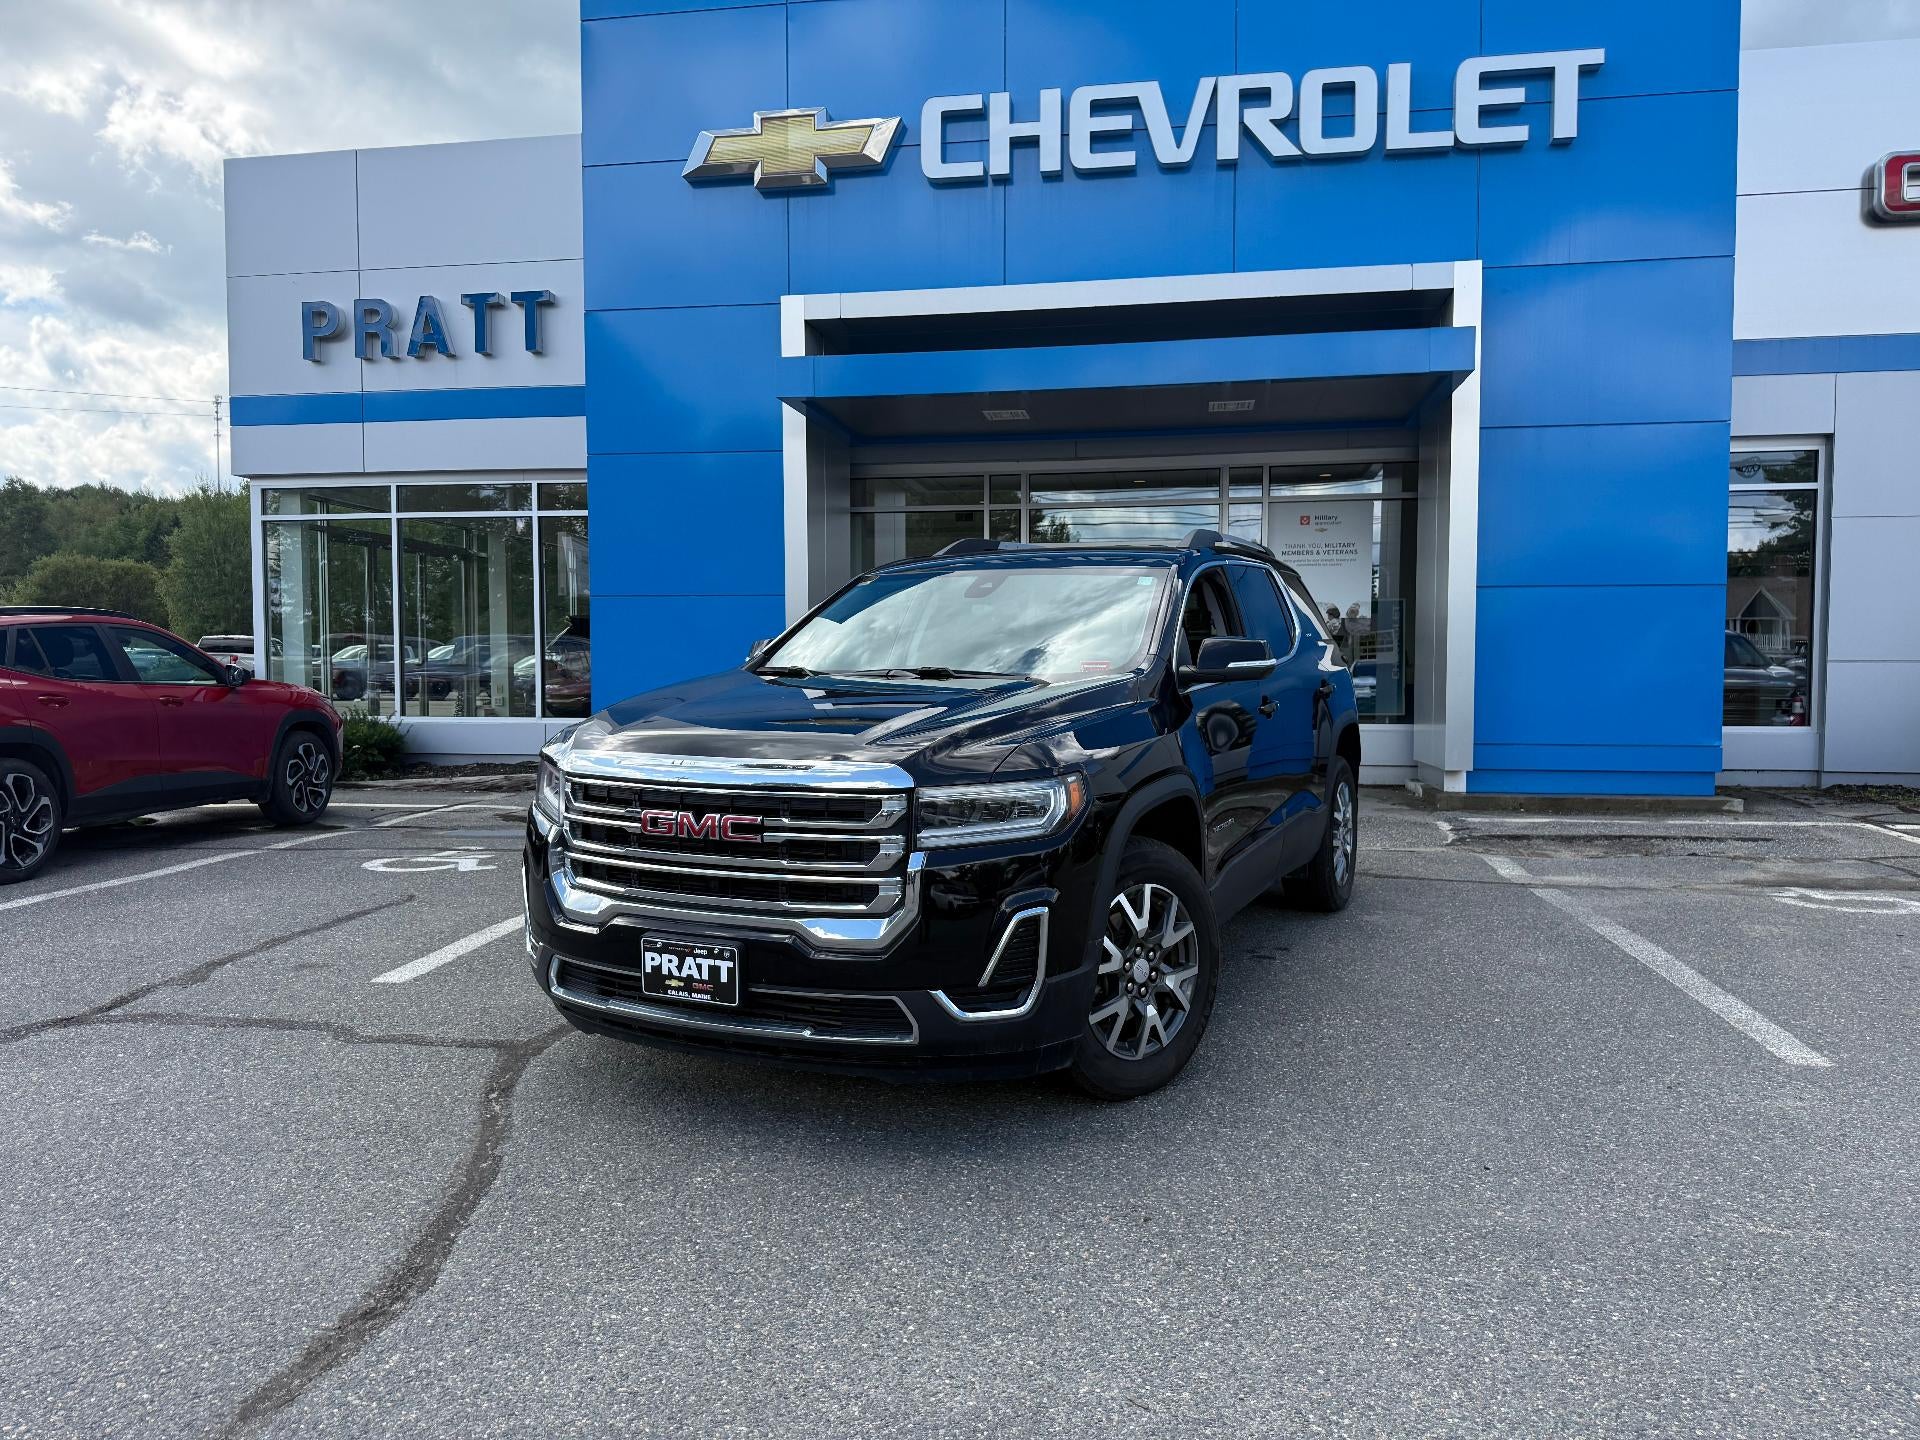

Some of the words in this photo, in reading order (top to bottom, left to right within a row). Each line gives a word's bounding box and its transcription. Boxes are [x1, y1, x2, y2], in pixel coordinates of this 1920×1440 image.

[919, 48, 1605, 184] CHEVROLET
[301, 289, 556, 363] PRATT
[1307, 543, 1323, 551] YOU,
[640, 809, 763, 843] GMC
[693, 947, 708, 956] Jeep
[644, 951, 734, 983] PRATT
[667, 989, 691, 998] CALAIS,
[691, 992, 712, 1000] MAINE
[692, 982, 714, 991] GMC
